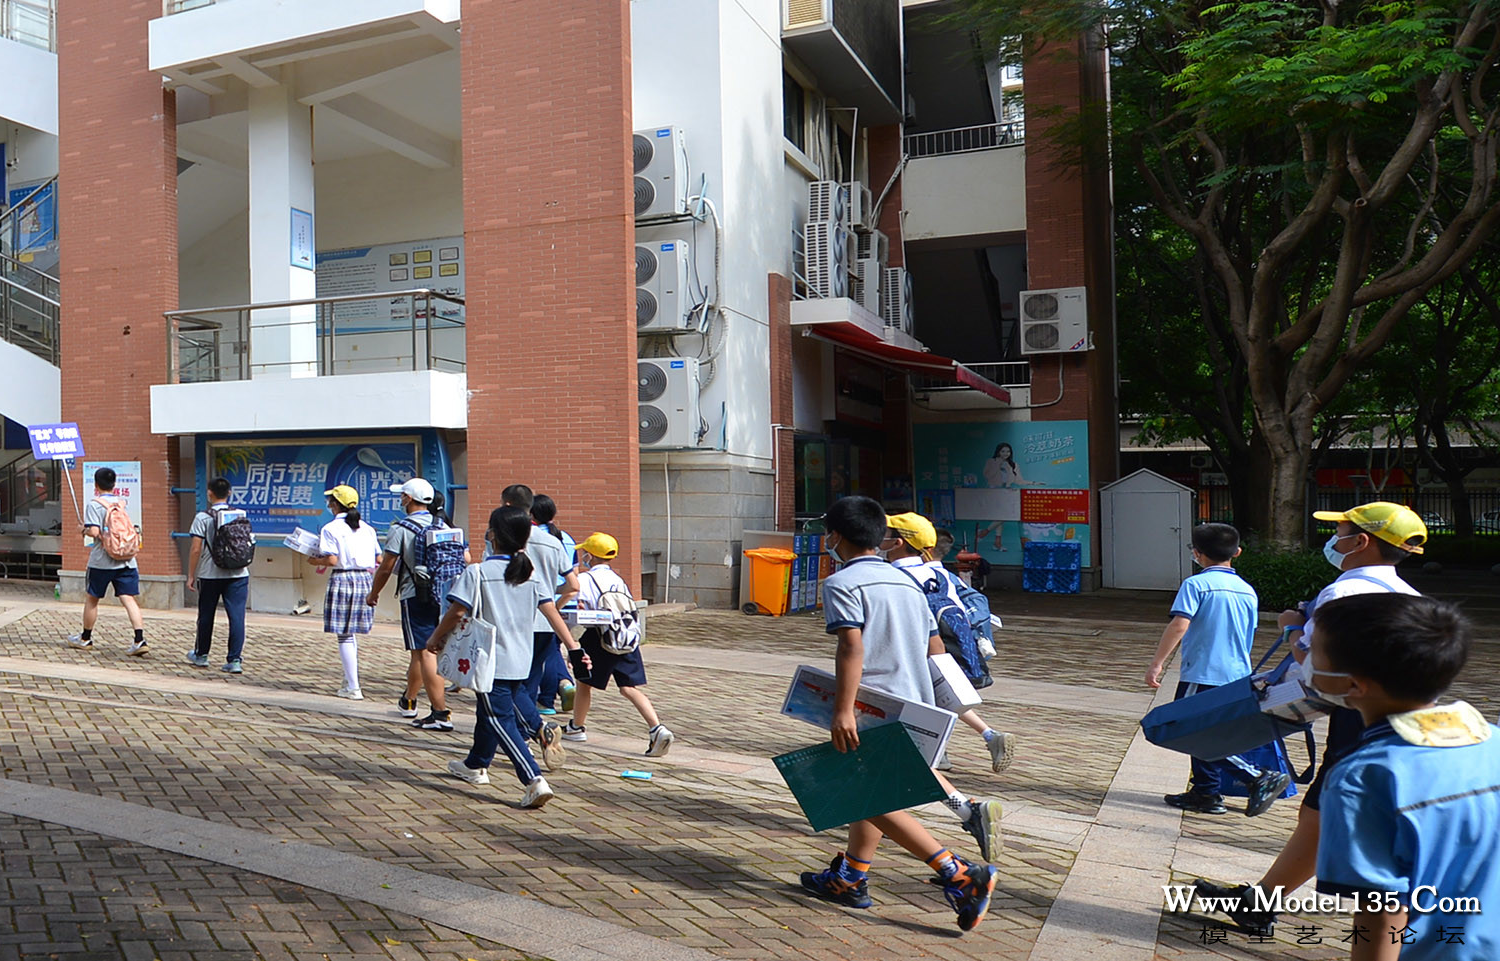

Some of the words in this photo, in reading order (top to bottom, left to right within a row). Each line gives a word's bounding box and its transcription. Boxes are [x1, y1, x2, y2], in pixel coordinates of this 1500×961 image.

[249, 463, 328, 486] 厉行节约
[228, 485, 314, 506] 反对浪费
